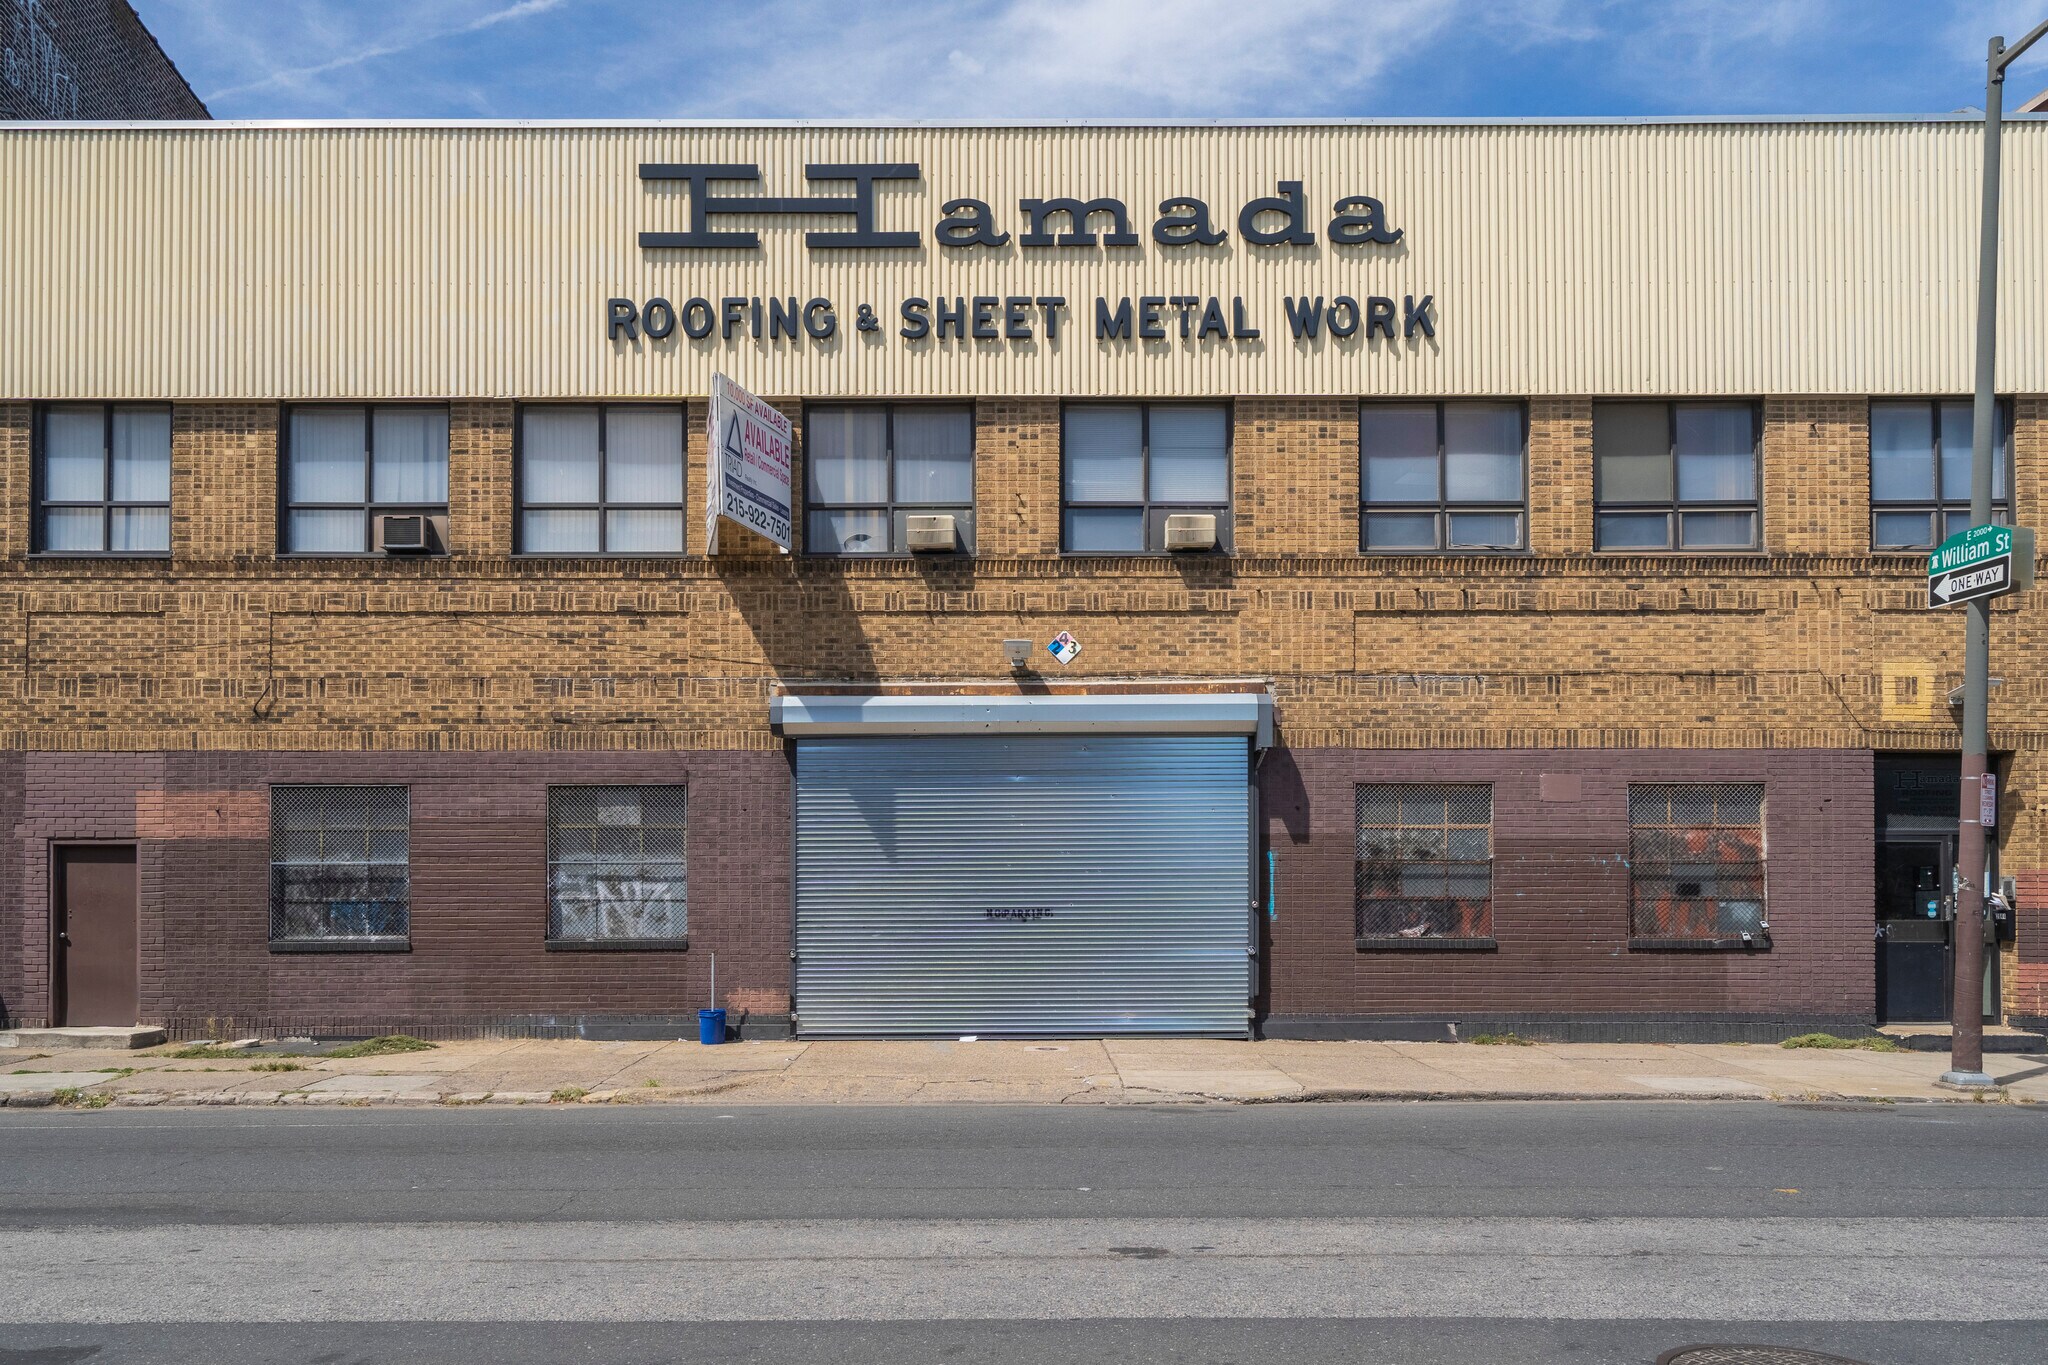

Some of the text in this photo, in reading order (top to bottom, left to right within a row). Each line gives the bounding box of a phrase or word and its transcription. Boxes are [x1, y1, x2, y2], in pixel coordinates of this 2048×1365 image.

[638, 162, 1404, 249] Hamada
[606, 294, 1436, 341] ROOFING & SHEET METAL WORK
[746, 396, 753, 409] SF
[754, 401, 788, 433] AVAILABLE
[744, 419, 790, 469] AVAILABLE
[724, 452, 743, 477] TRIAD
[744, 448, 755, 466] Retail
[758, 455, 779, 478] Commercial
[779, 467, 790, 486] Space
[726, 492, 791, 542] 215-922-7501
[1967, 528, 1987, 540] E 2000
[1941, 533, 2010, 568] William St
[1951, 567, 2000, 592] ONE WAY
[1052, 639, 1061, 655] 2
[1059, 633, 1069, 644] 4
[1068, 641, 1077, 654] 3
[1894, 770, 1959, 789] Hamada
[986, 908, 1052, 918] NO PARKING
